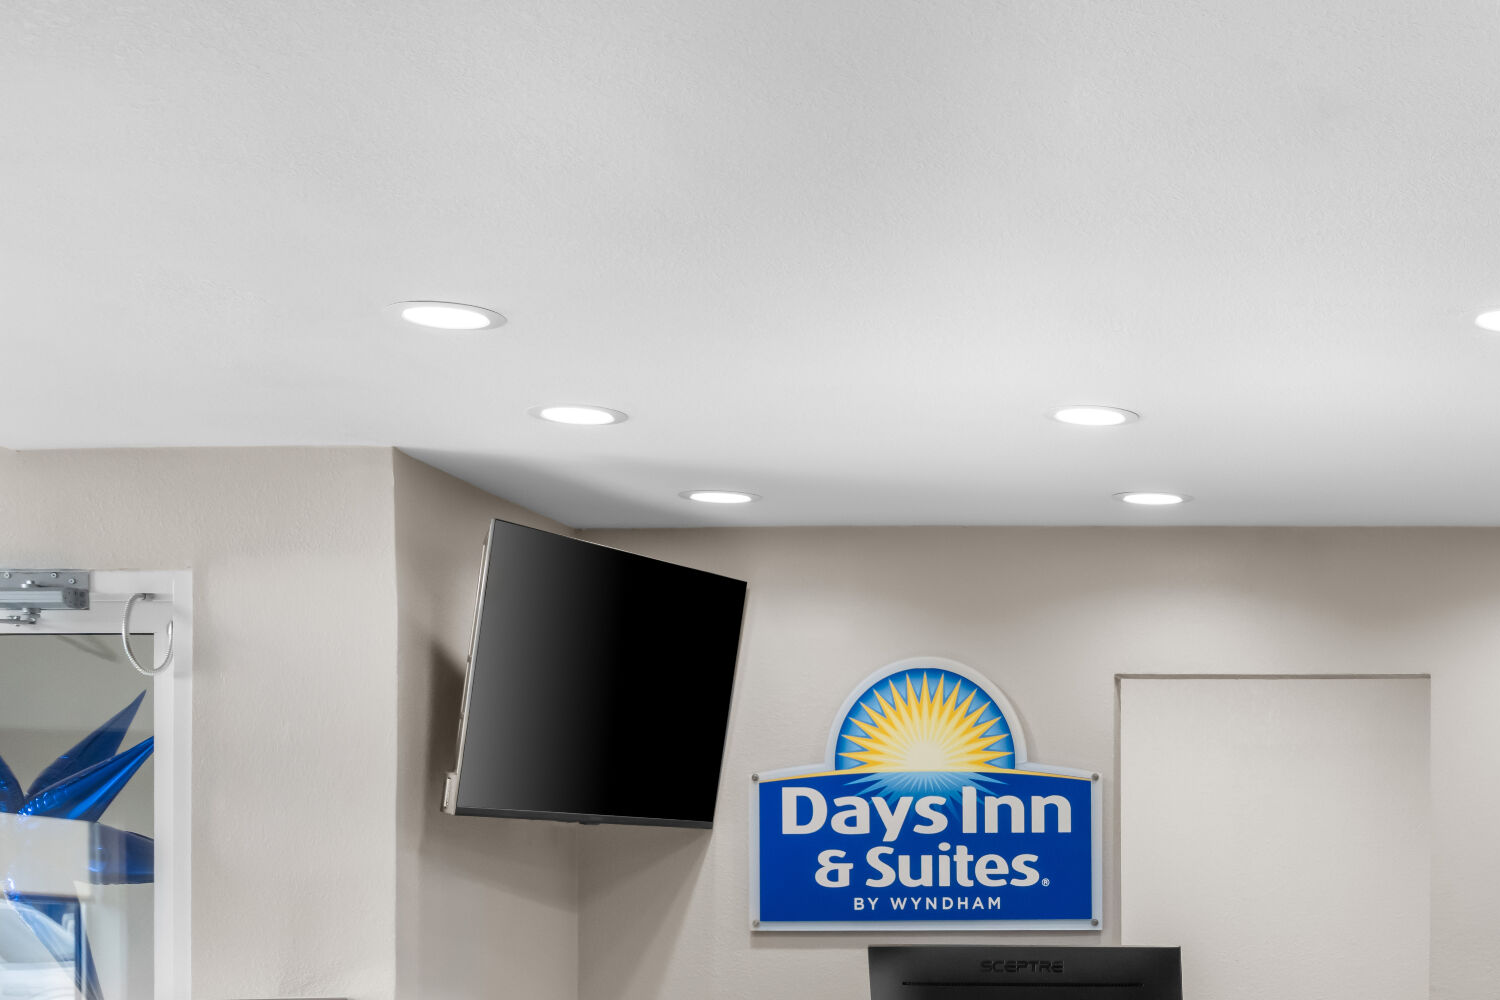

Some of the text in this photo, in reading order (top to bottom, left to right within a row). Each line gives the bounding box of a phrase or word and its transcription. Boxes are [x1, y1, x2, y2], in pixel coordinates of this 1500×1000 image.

[782, 786, 1072, 843] Days Inn
[815, 849, 853, 888] &
[853, 896, 1001, 911] BY WYNDHAM
[980, 960, 1065, 973] SCEPTRE
